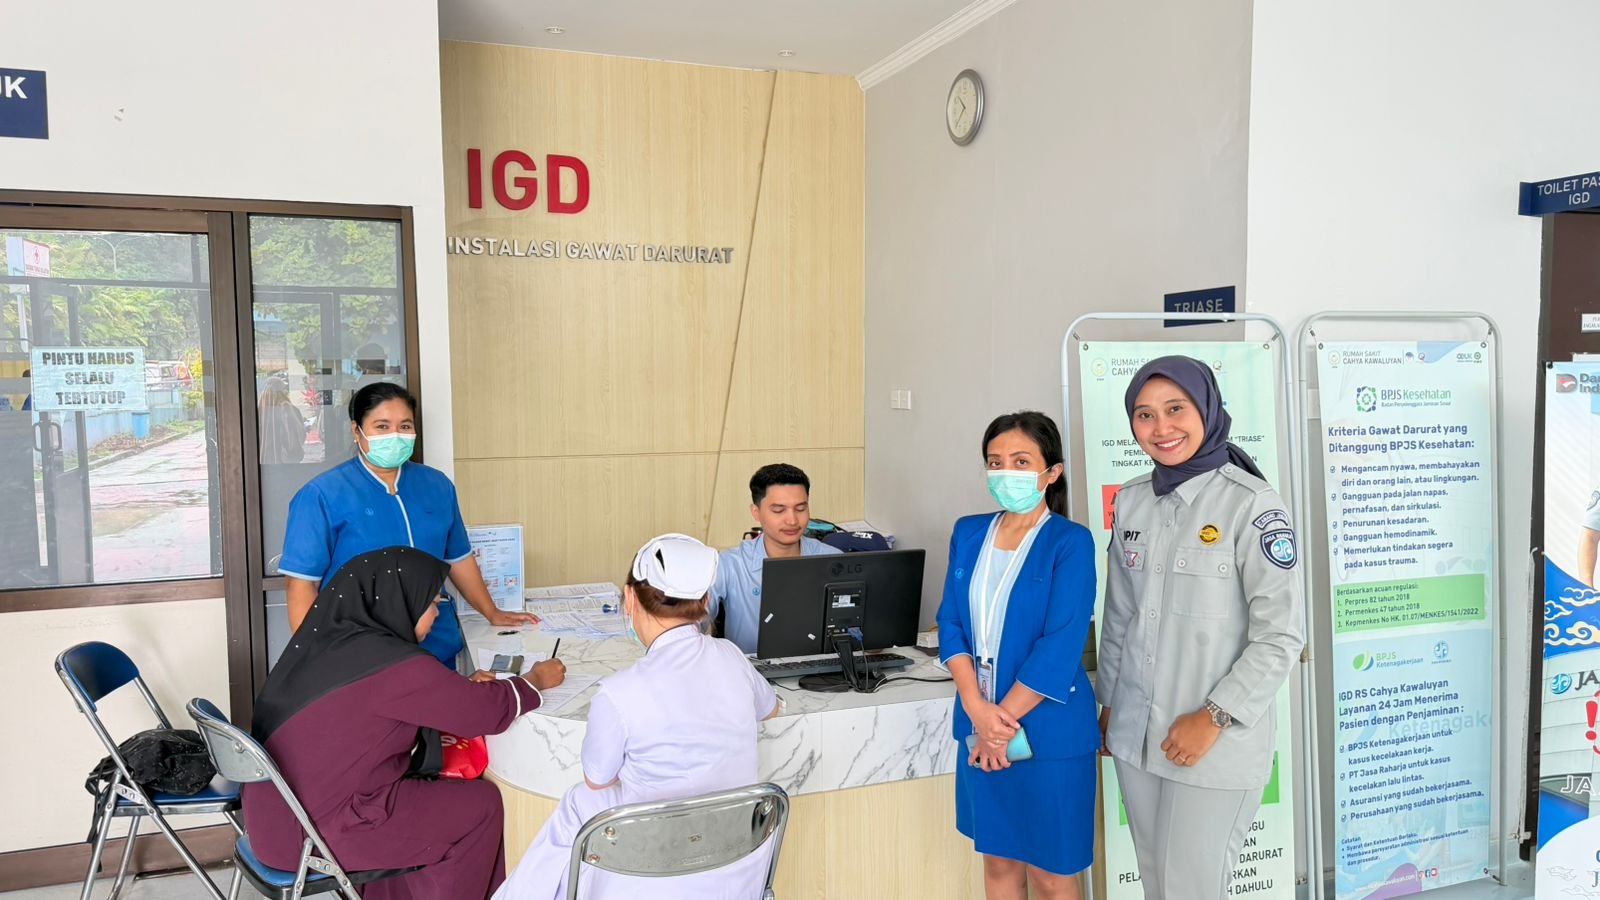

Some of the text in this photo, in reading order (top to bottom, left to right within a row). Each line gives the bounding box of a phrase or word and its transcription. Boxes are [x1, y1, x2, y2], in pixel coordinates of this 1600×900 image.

[467, 148, 590, 214] IGD
[1538, 179, 1578, 196] TOILET
[1568, 192, 1590, 205] IGD
[566, 242, 639, 261] GAWAT
[643, 245, 734, 264] DARURAT
[1174, 298, 1223, 312] TRIASE
[42, 352, 135, 365] PINTU HARUS
[1111, 358, 1140, 366] RUMAH
[65, 372, 114, 385] SELALU
[56, 391, 126, 405] TERTUTUP
[1381, 389, 1451, 400] BPJS Kesehatan
[1328, 424, 1468, 437] Kriteria Gawat Darurat yang
[1329, 439, 1474, 453] Ditanggung BPJS Kesehatan:
[1342, 461, 1480, 474] Mengancam nyawa, membahayakan
[1342, 479, 1355, 487] diri
[1372, 478, 1395, 487] orang
[1433, 474, 1479, 483] lingkungan.
[1342, 492, 1382, 501] Gangguan
[1383, 491, 1402, 499] pada
[1403, 489, 1422, 498] jalan
[1391, 503, 1405, 512] dan
[1406, 502, 1442, 511] sirkulasi.
[1343, 516, 1429, 528] Penurunan kesadaran.
[1343, 529, 1438, 542] Gangguan hemodinamik.
[1344, 541, 1453, 555] Memerlukan tindakan segera
[847, 563, 862, 574] LG
[1344, 557, 1418, 570] pada kasus trauma.
[1336, 586, 1373, 597] Berdasarkan
[1345, 597, 1368, 606] Perpres
[1378, 594, 1395, 602] tahun
[1396, 593, 1410, 601] 2018
[1345, 607, 1378, 616] Permenkes
[1380, 605, 1387, 613] 47
[1388, 604, 1405, 612] tahun
[1345, 618, 1380, 628] Kepmenkes
[1381, 615, 1389, 623] No
[1376, 652, 1396, 661] BPJS
[1376, 657, 1423, 668] Ketenagakerjaan
[1575, 670, 1600, 691] JA
[1339, 679, 1449, 701] IGD RS Cahya Kawaluyan
[1339, 692, 1459, 716] Layanan 24 Jam Menerima
[1339, 719, 1369, 730] Pasien
[1371, 714, 1405, 726] dengan
[1407, 706, 1459, 720] Penjaminan
[1348, 729, 1453, 752] BPJS Ketenagakerjaan untuk
[1348, 746, 1434, 765] kasus kecelakaan kerja.
[1349, 756, 1451, 779] PT Jasa Raharja untuk kasus
[1388, 776, 1400, 786] lalu
[1402, 773, 1424, 783] lintas.
[1350, 778, 1472, 806] Asuransi yang sudah bekerjasama.
[1350, 790, 1484, 820] Perusahaan yang sudah bekerjasama.
[1239, 848, 1283, 864] DARURAT
[1236, 879, 1273, 895] DAHULU
